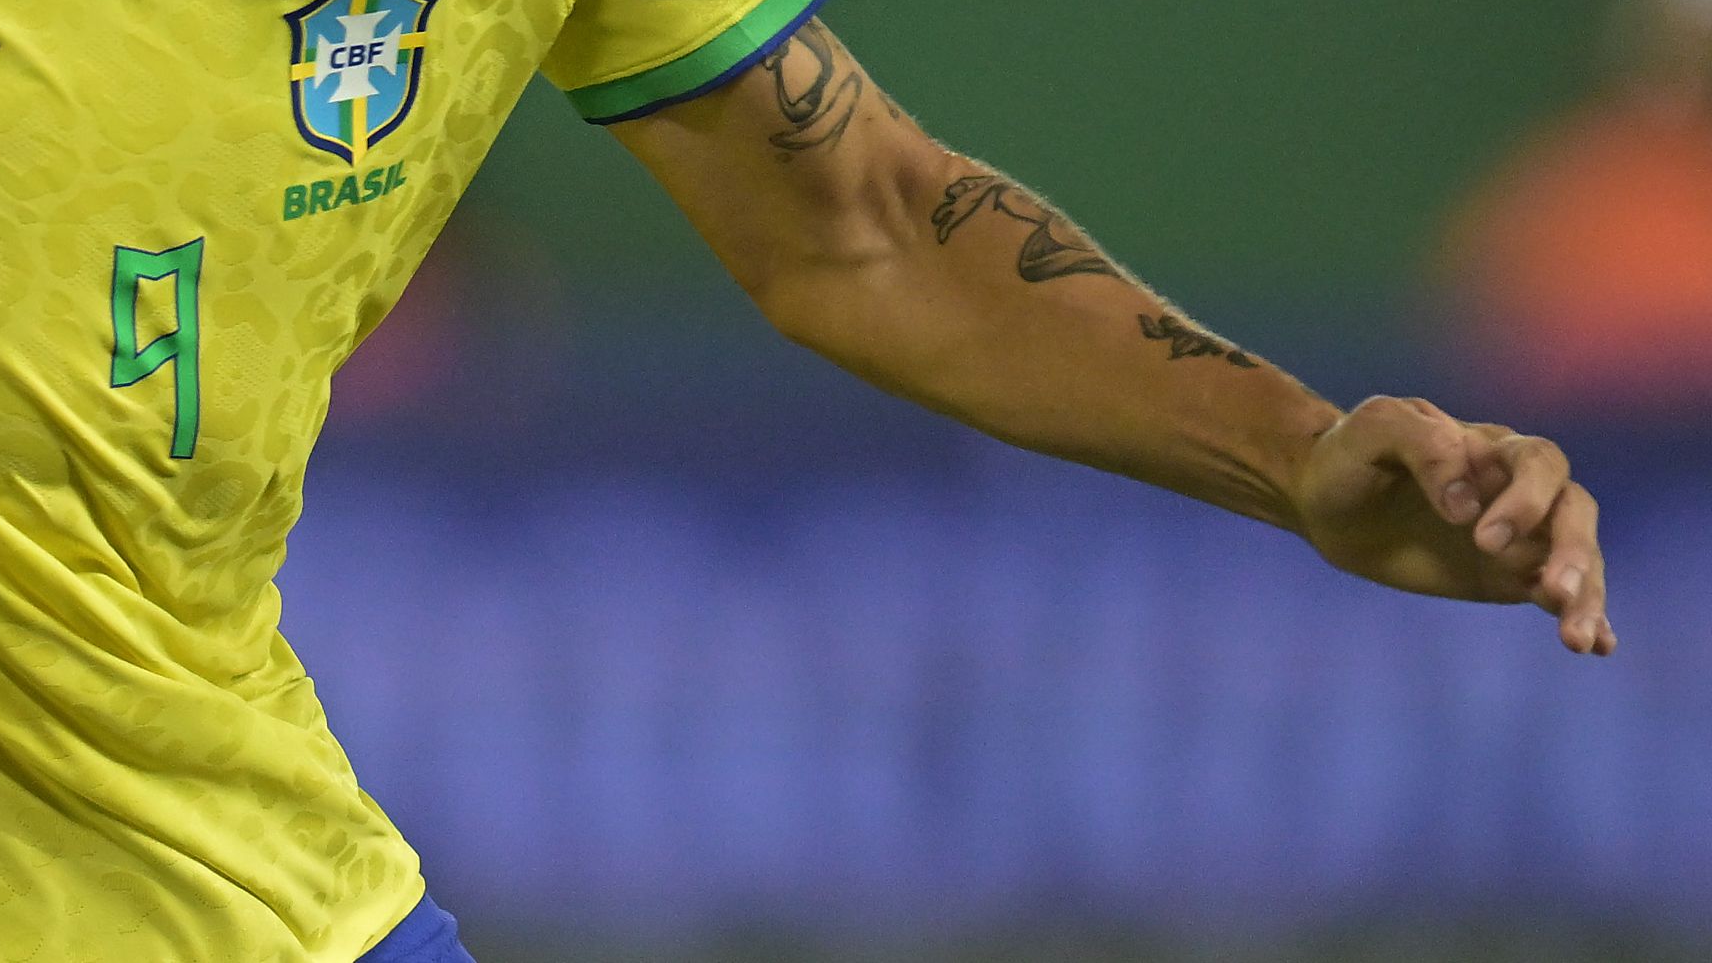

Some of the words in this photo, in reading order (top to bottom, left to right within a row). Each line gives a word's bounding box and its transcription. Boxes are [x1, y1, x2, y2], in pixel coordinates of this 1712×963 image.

[330, 41, 385, 69] CBF
[283, 160, 407, 221] BRASIL
[109, 236, 205, 460] 9
